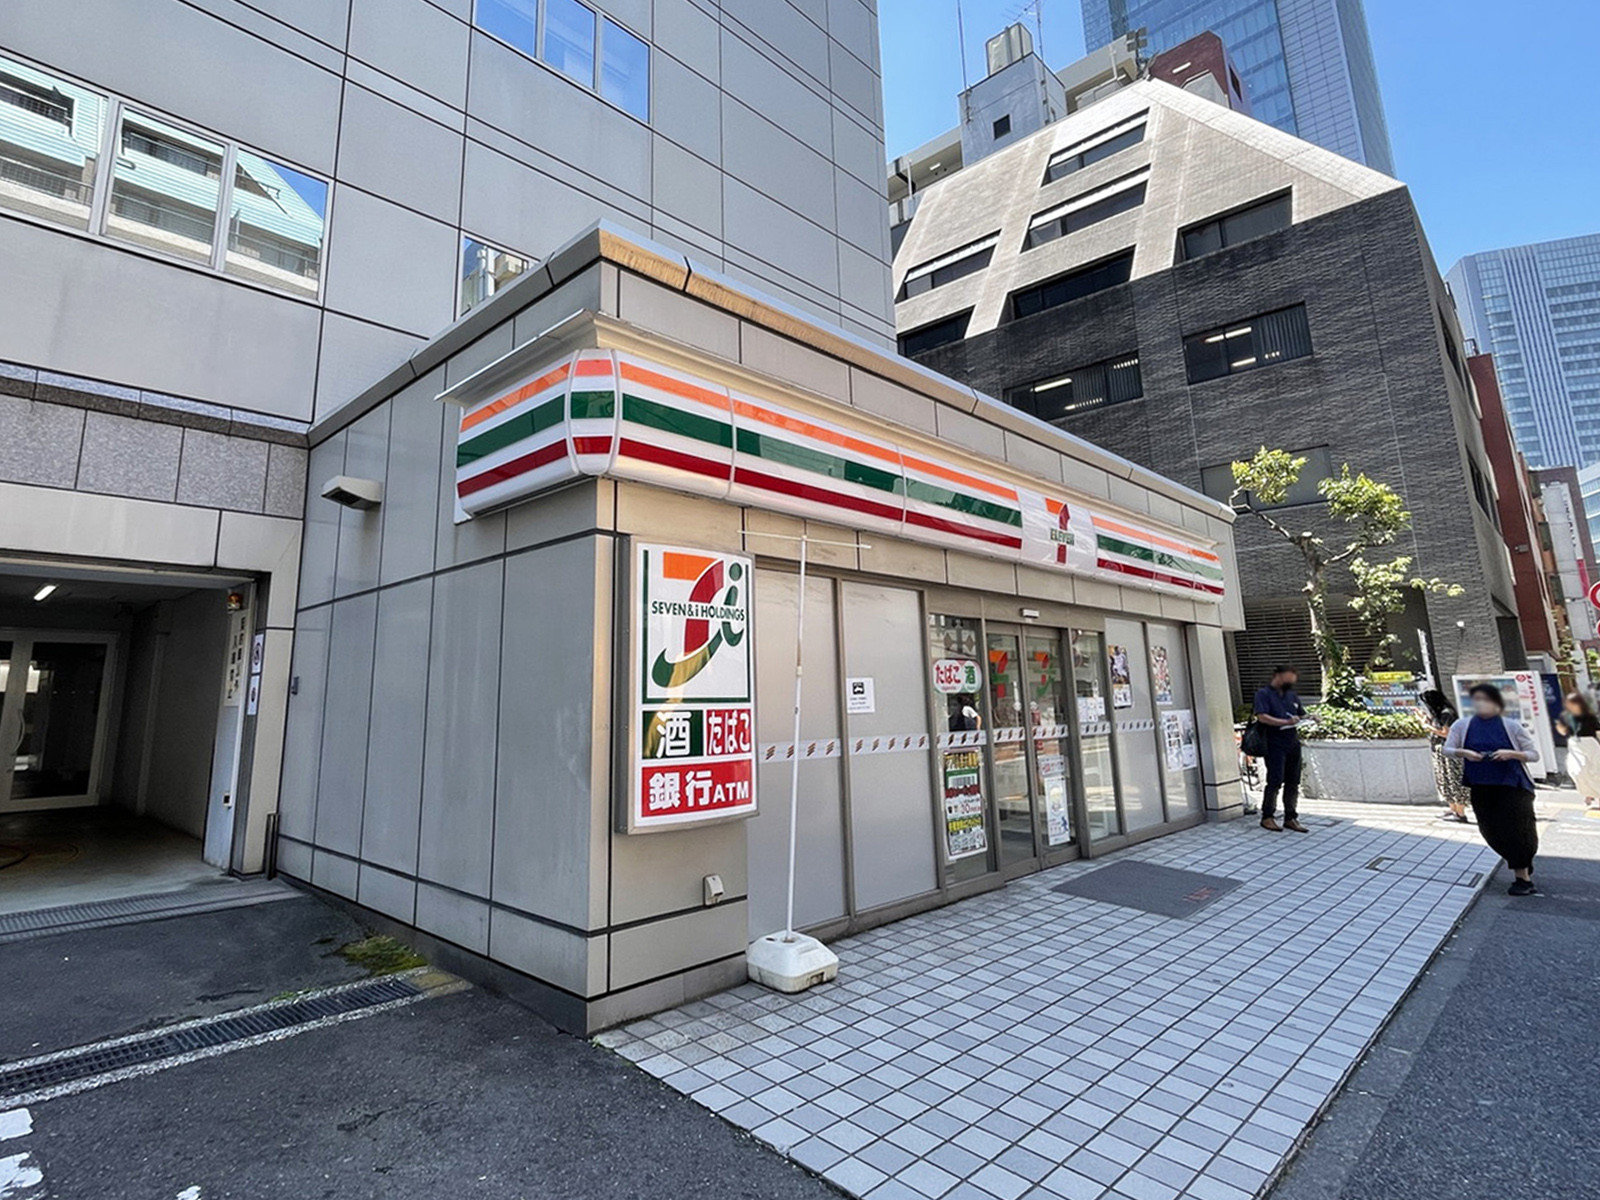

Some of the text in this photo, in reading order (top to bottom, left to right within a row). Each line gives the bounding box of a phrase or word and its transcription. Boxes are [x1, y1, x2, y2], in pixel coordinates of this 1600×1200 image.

[700, 601, 745, 621] HOLDINGS
[935, 664, 961, 684] たばこ
[656, 711, 692, 758] 酒
[707, 711, 751, 755] たばこ
